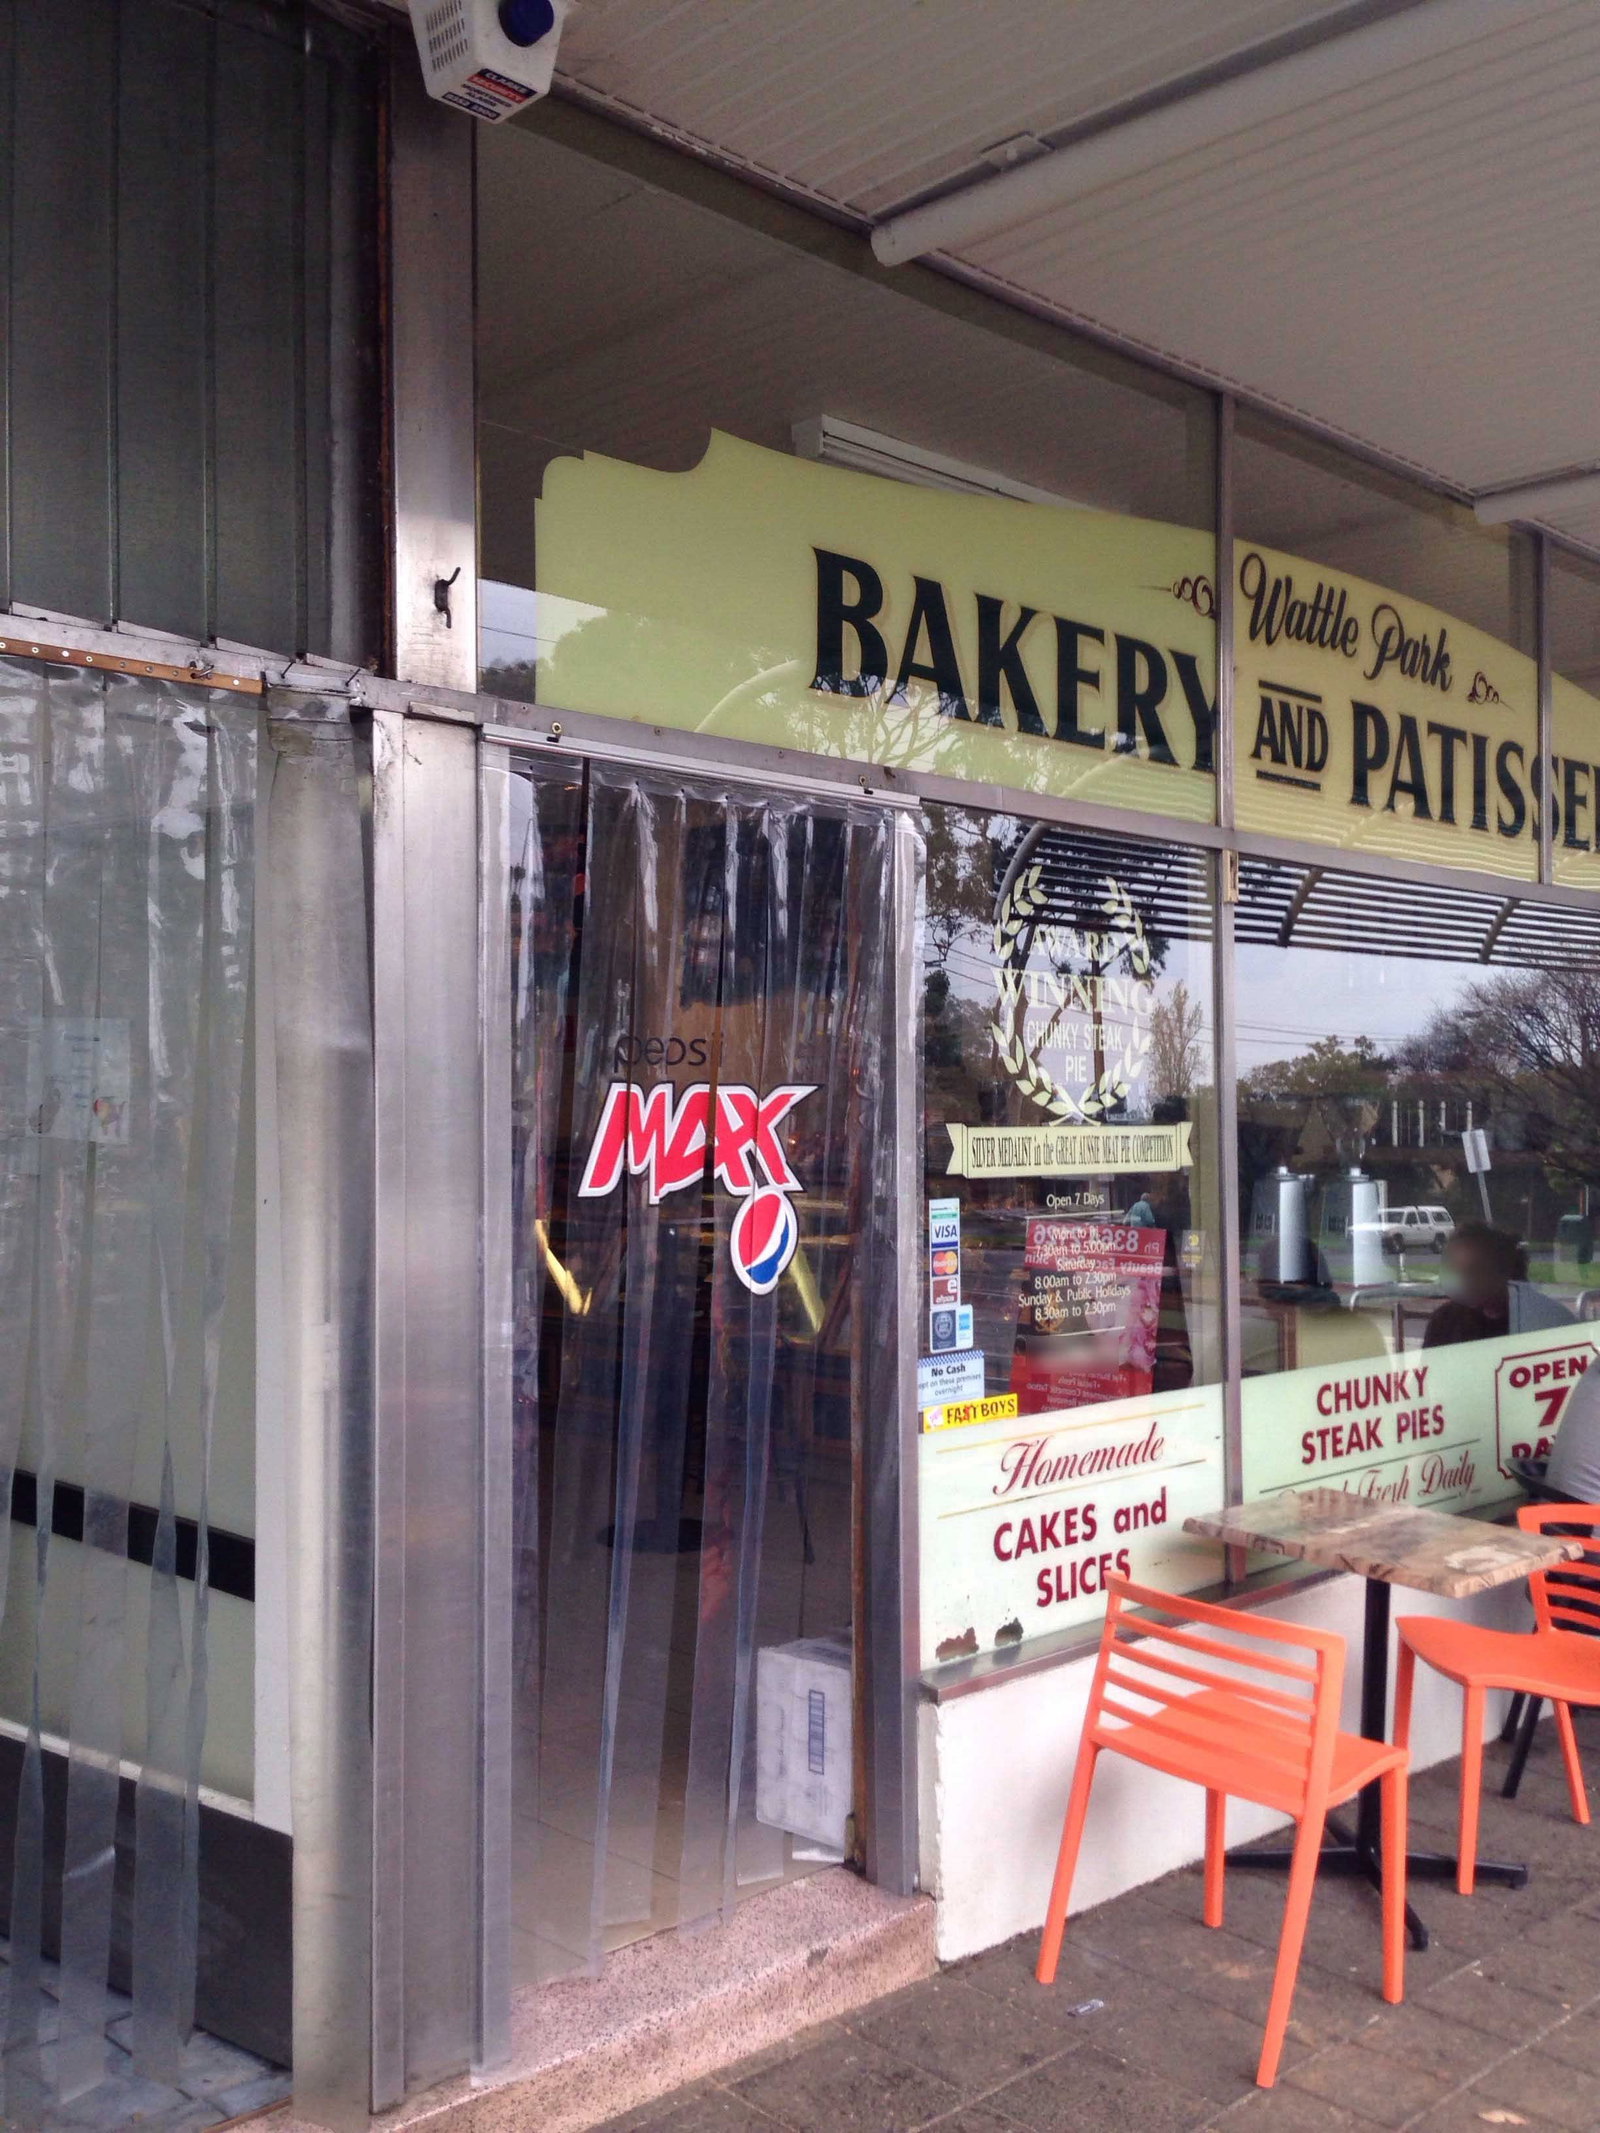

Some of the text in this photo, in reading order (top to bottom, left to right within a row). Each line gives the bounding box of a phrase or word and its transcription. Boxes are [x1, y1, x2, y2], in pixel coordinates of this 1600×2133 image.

[1240, 552, 1454, 693] Wattle Park
[810, 547, 1600, 856] BAKERY AND PATISSE
[1028, 926, 1120, 962] AWARD
[992, 966, 1156, 1017] WINNING
[1026, 1020, 1123, 1052] CHUNKY STEAK
[1065, 1055, 1087, 1083] PIE
[577, 1081, 820, 1206] MAX
[972, 1136, 996, 1168] SILVER
[998, 1136, 1033, 1167] MEDALIST
[1034, 1135, 1041, 1165] in
[1043, 1133, 1054, 1165] the
[1056, 1135, 1077, 1165] GREAT
[1079, 1134, 1100, 1165] AUSSIE
[1102, 1135, 1119, 1164] MEAT
[1132, 1134, 1174, 1163] COMPETITION
[1046, 1193, 1104, 1209] Open 7 Days
[934, 1225, 958, 1238] VISA
[1071, 1246, 1081, 1254] to
[1018, 1285, 1131, 1307] Sunday & Public Holidays
[1034, 1271, 1117, 1290] 8.00am to 2.30pm
[1035, 1301, 1116, 1321] 8.30am to 2.30pm
[931, 1363, 966, 1377] No Cash
[940, 1377, 955, 1386] these
[957, 1373, 981, 1386] premises
[1509, 1355, 1588, 1388] OPEN
[935, 1385, 963, 1396] overnight
[1316, 1365, 1429, 1416] CHUNKY
[1534, 1386, 1571, 1427] 7
[981, 1399, 1015, 1417] BOYS
[1301, 1404, 1445, 1465] STEAK PIES
[992, 1421, 1165, 1495] Homemade
[1418, 1450, 1476, 1496] Daily
[993, 1486, 1167, 1562] CAKES and
[1036, 1548, 1131, 1608] SLICES
